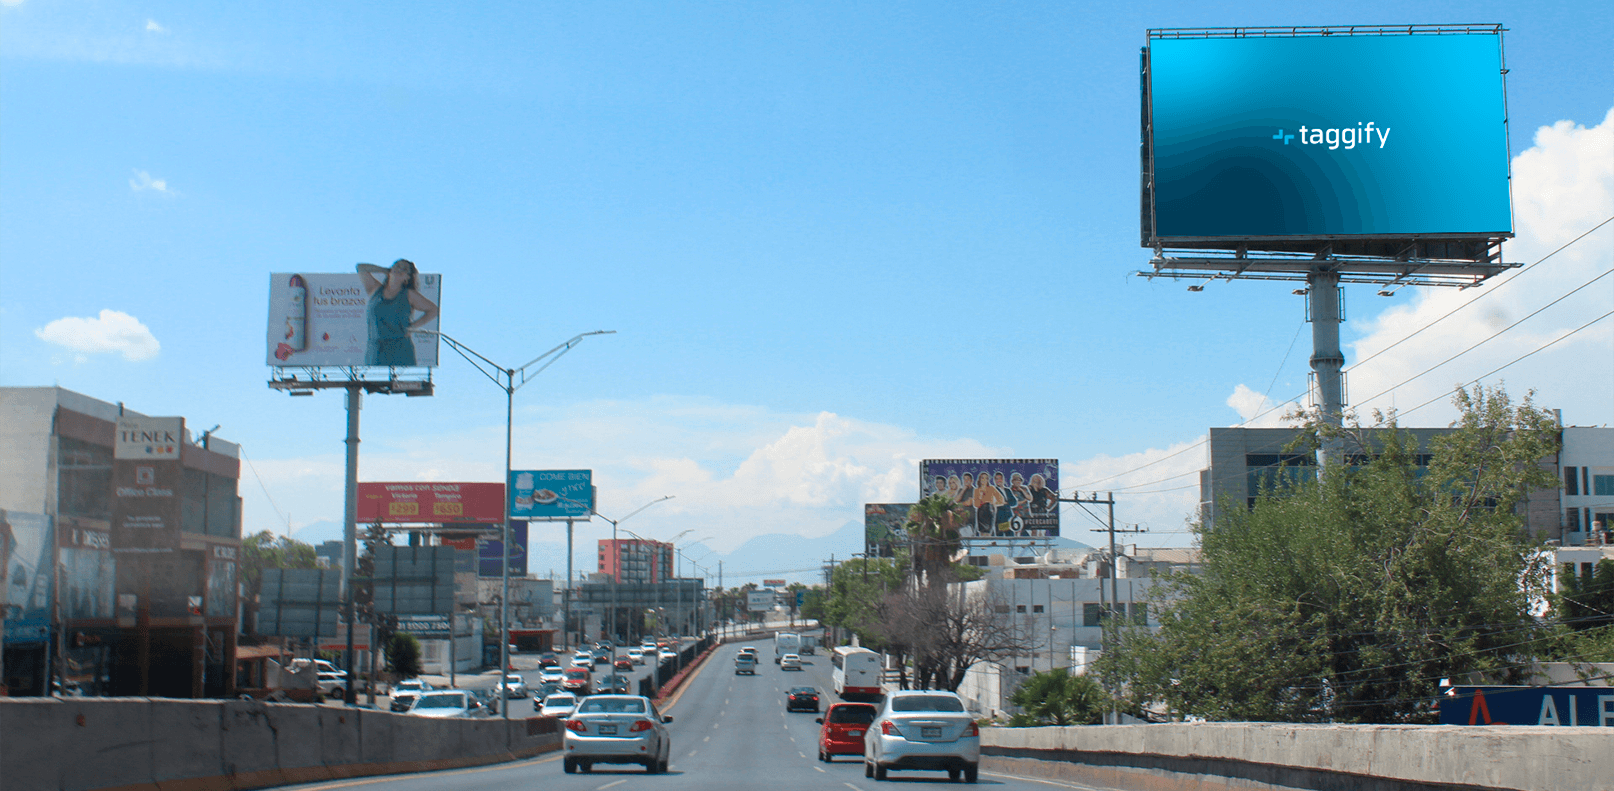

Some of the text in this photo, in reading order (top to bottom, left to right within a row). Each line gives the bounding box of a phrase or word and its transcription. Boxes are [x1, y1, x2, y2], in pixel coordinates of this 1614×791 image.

[1298, 121, 1391, 150] taggify
[320, 286, 360, 296] Levanta
[313, 296, 366, 306] tus brazos
[122, 431, 176, 443] TENEK
[539, 472, 590, 481] COME BIEN
[391, 503, 417, 514] $299
[1010, 515, 1021, 531] 6
